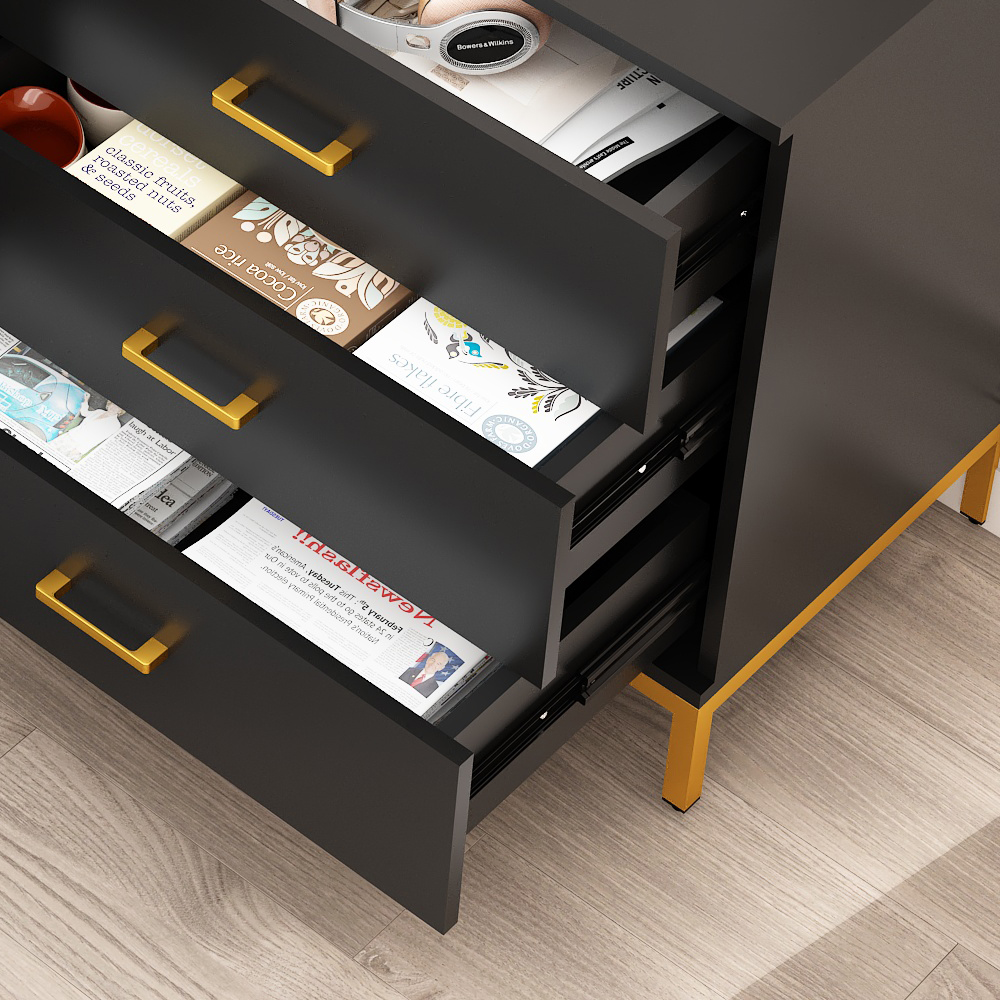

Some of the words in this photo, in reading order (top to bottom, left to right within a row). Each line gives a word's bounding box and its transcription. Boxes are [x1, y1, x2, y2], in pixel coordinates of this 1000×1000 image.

[457, 41, 483, 51] Bowers
[488, 39, 514, 47] Wilkins
[616, 66, 649, 91] CTURE
[105, 146, 154, 179] classic
[153, 175, 197, 209] fruits,
[119, 134, 202, 189] cereals
[81, 163, 97, 175] &
[95, 172, 137, 202] seeds
[92, 155, 149, 192] roasted
[146, 189, 182, 214] nuts
[214, 244, 247, 268] rice
[245, 262, 297, 302] Cocoa
[387, 352, 438, 389] flakes
[438, 383, 482, 419] Fibre
[128, 421, 147, 436] laugh
[495, 415, 535, 442] ORGANIC
[497, 440, 530, 452] DOVES
